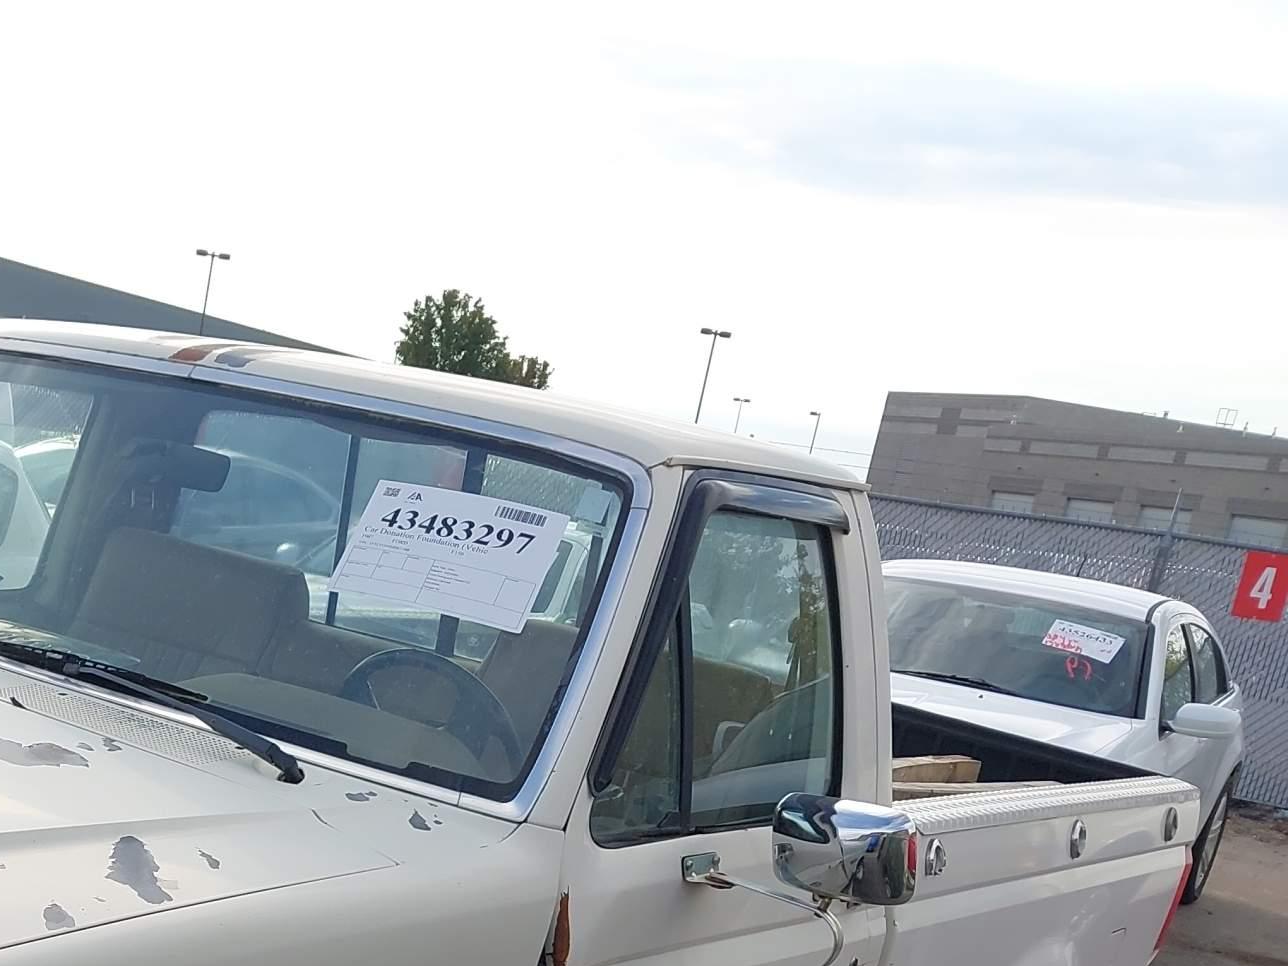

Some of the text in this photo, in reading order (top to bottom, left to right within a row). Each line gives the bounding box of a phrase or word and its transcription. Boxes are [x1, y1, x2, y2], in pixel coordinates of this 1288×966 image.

[364, 525, 379, 535] Car
[379, 527, 415, 541] Donation
[416, 534, 460, 550] Foundation
[381, 507, 537, 555] 43483297
[1249, 566, 1278, 609] 4
